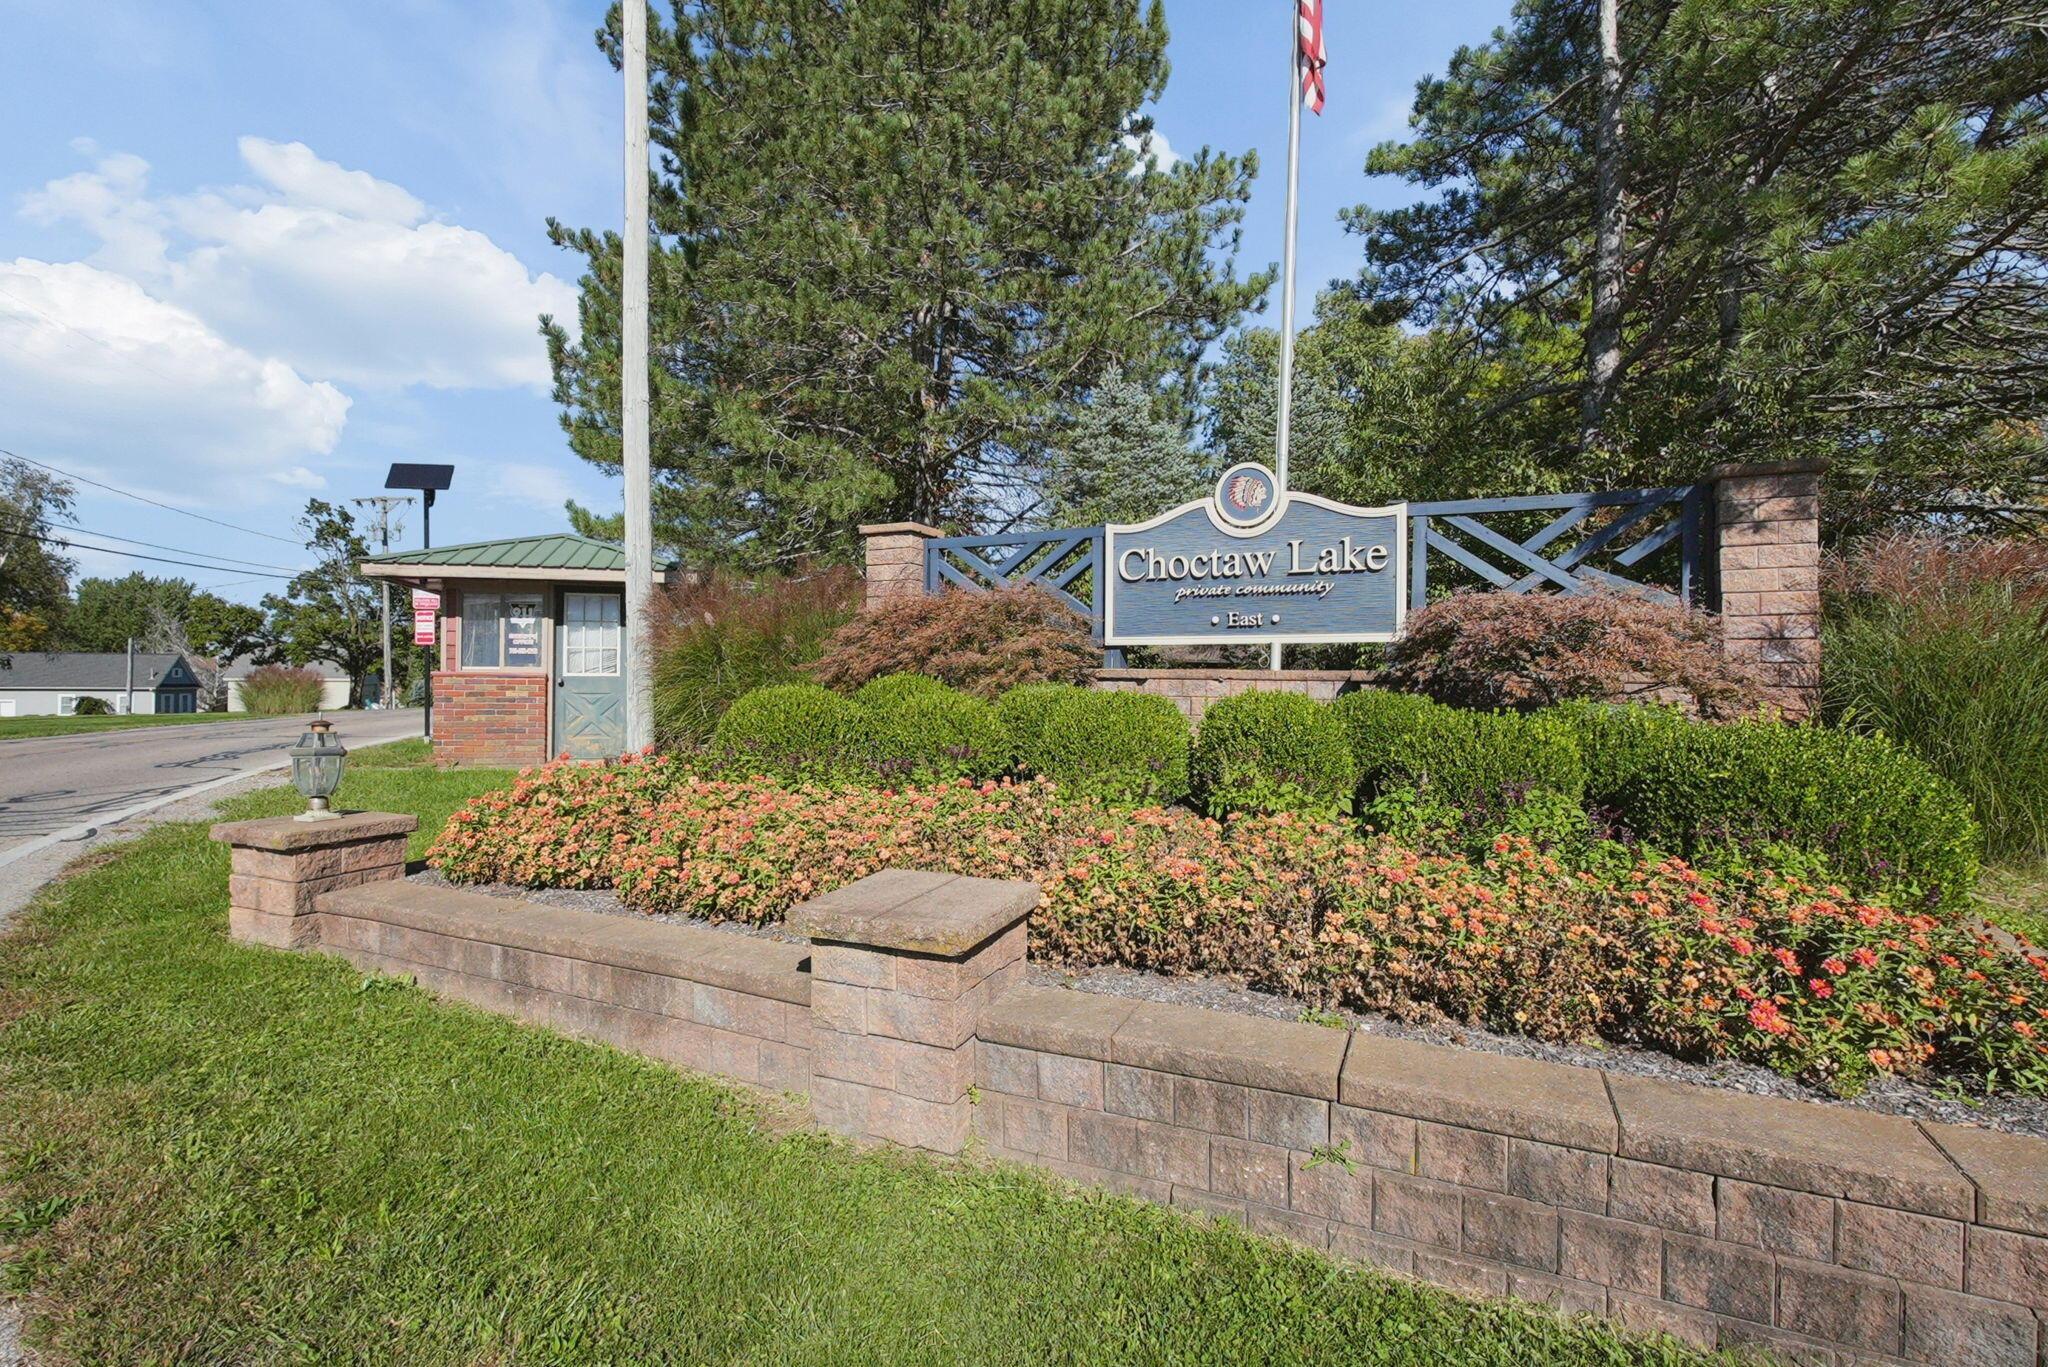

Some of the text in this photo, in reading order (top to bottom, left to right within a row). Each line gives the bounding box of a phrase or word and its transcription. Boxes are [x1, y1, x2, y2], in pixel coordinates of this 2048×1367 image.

[1118, 536, 1389, 582] Choctaw Lake
[1174, 580, 1335, 603] private community
[1227, 611, 1264, 628] East
